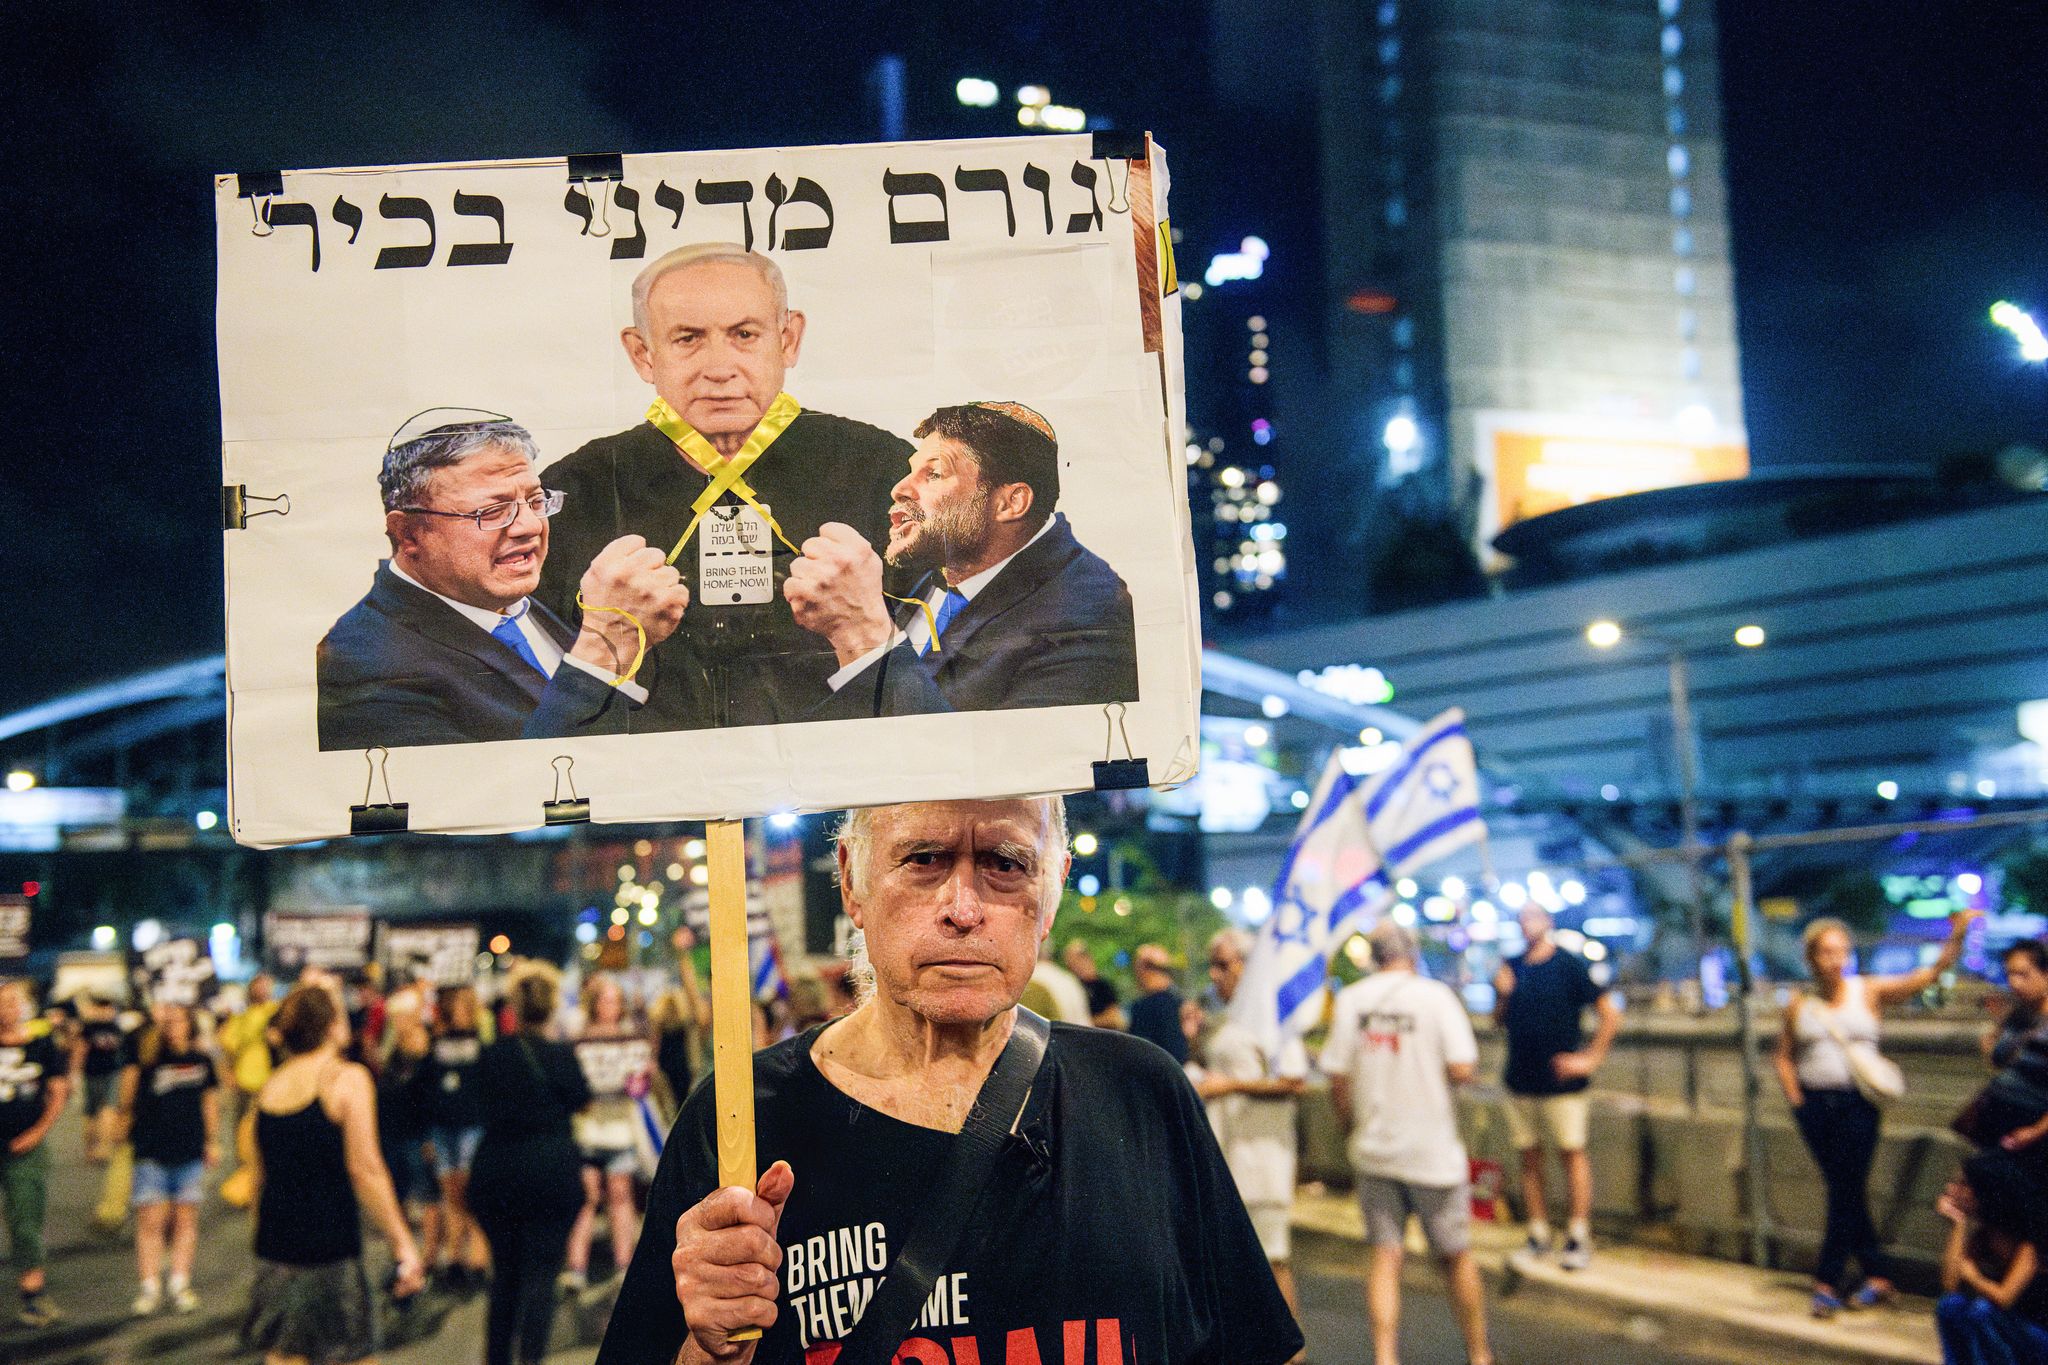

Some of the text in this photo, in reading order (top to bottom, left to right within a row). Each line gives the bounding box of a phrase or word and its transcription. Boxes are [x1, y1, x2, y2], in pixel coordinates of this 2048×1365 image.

[261, 160, 1103, 273] גורם מדיני בכיר
[711, 521, 758, 533] הלב שלנו
[711, 535, 735, 545] בעזה
[705, 566, 767, 577] BRING THEM
[786, 1221, 887, 1295] BRING
[876, 1272, 969, 1331] ME
